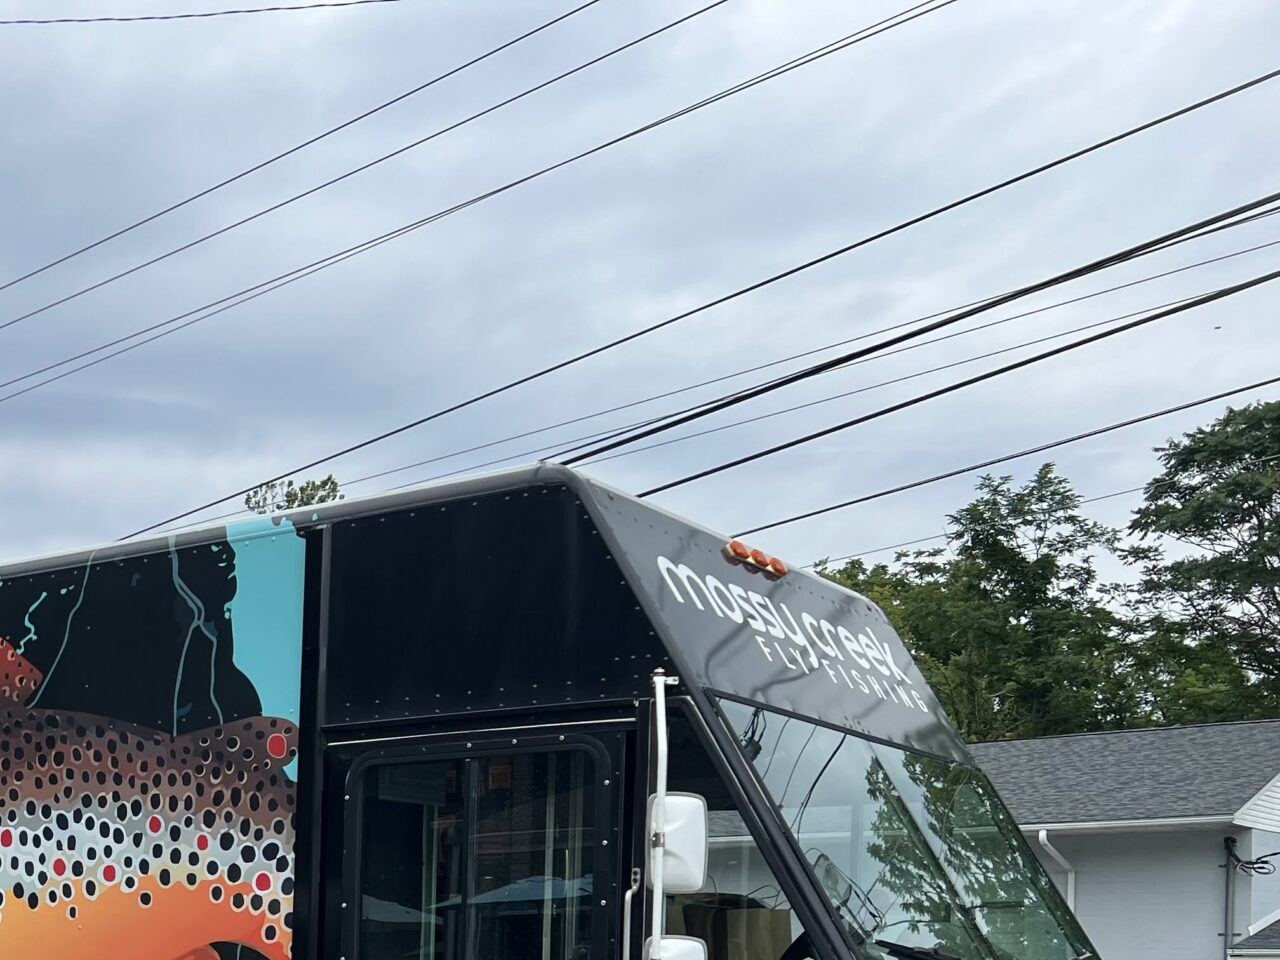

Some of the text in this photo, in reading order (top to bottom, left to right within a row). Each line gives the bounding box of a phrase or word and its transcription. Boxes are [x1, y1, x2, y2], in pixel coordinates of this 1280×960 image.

[657, 555, 912, 684] mossy creek
[755, 635, 929, 713] FLY FISHING
